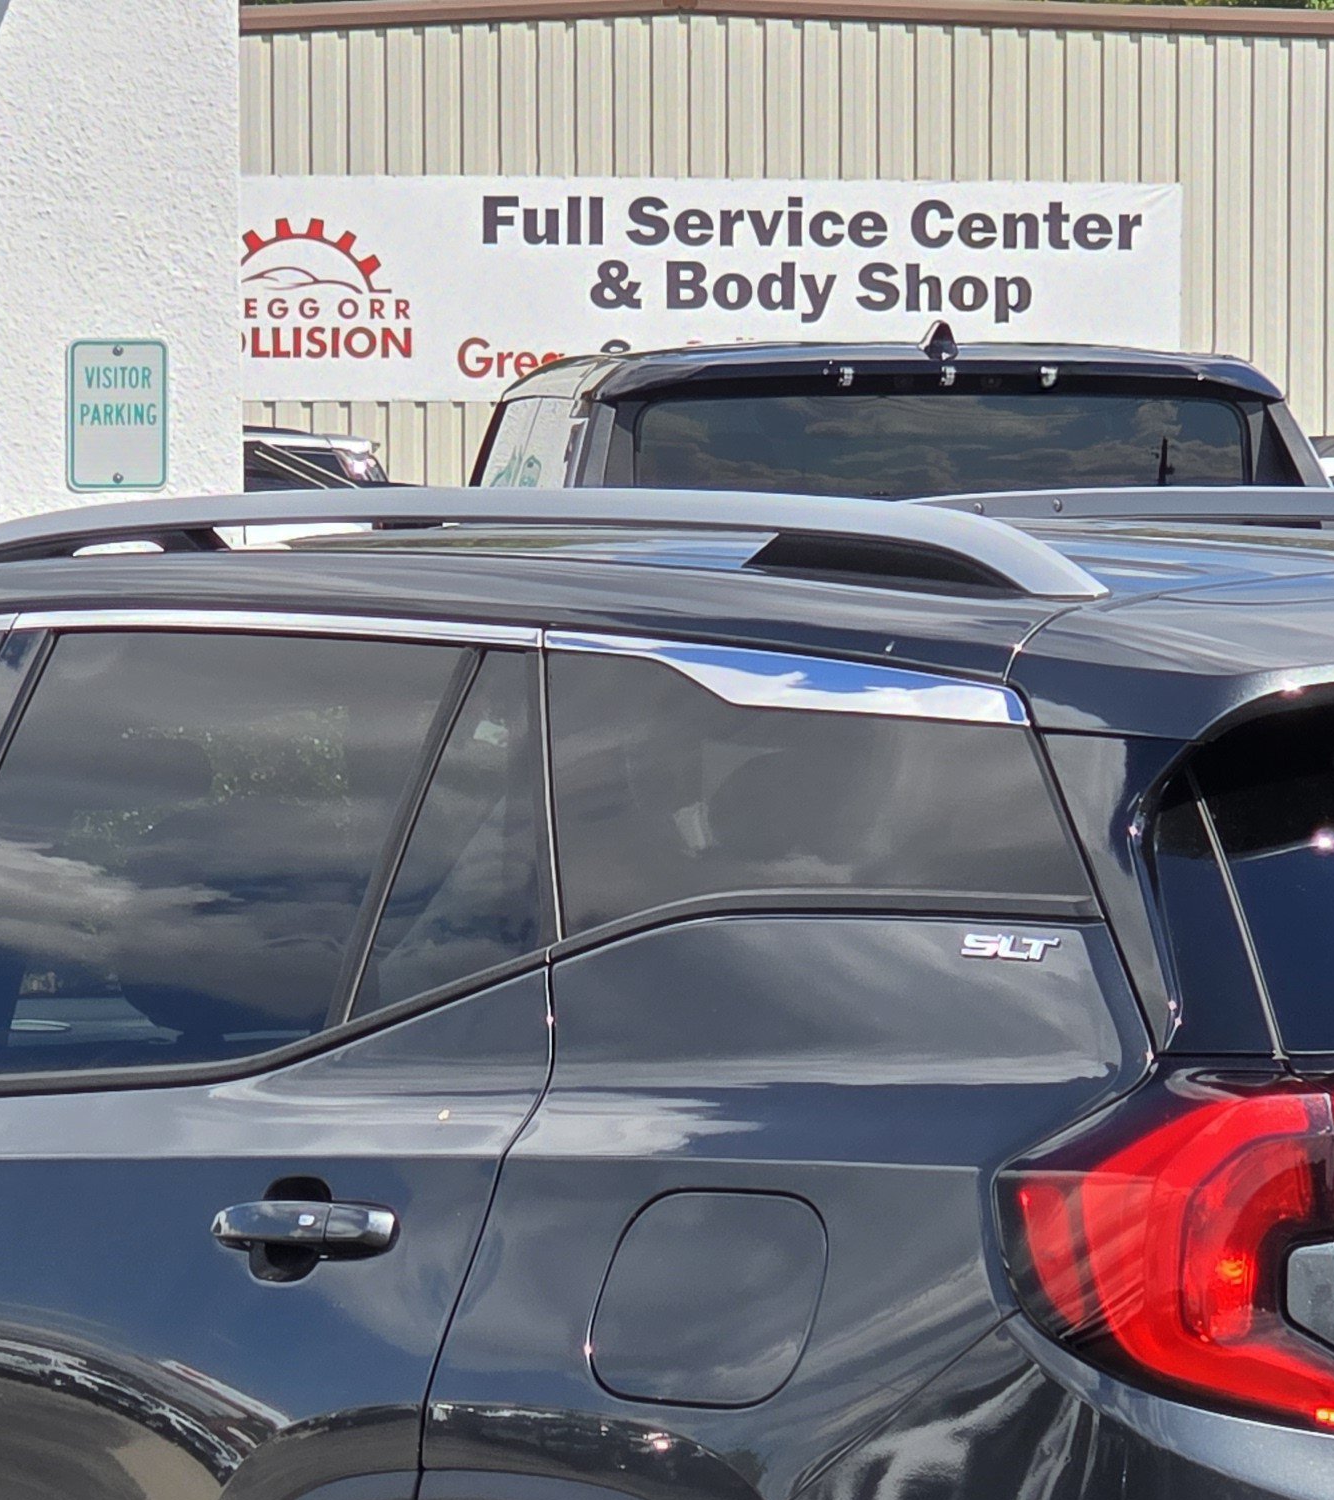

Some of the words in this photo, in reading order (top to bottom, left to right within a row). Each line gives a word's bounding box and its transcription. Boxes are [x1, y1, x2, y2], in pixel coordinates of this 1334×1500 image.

[482, 195, 604, 246] Full
[625, 196, 888, 248] Service
[910, 199, 1143, 250] Center
[589, 259, 643, 310] &
[666, 260, 837, 324] Body
[855, 262, 1033, 324] Shop
[243, 298, 320, 320] EGG
[337, 298, 411, 320] ORR
[241, 326, 413, 360] LLISION
[84, 366, 152, 389] VISITOR
[79, 403, 157, 426] PARKING
[960, 933, 1060, 961] SLT
